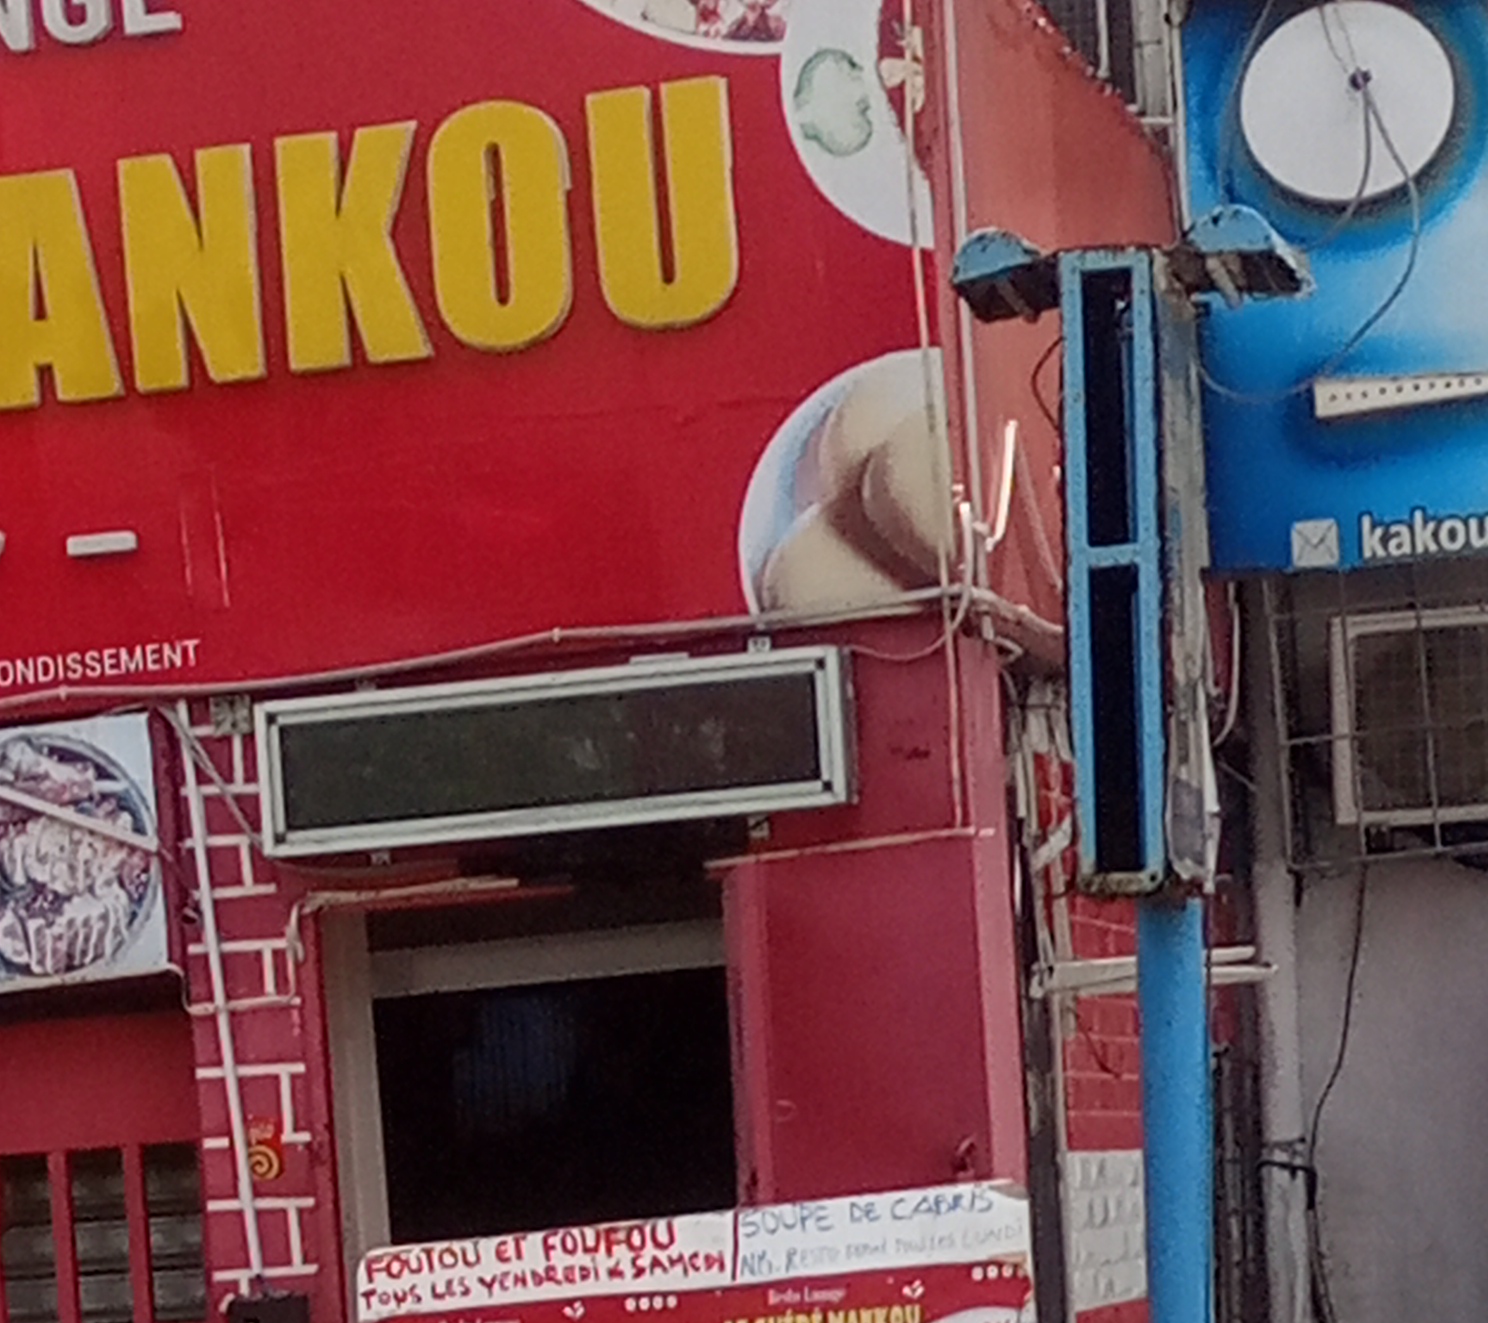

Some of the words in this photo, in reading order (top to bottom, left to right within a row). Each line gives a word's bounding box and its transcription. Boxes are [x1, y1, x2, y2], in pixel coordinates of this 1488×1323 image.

[1360, 508, 1488, 560] kakou
[740, 1204, 834, 1238] SOUPE
[890, 1188, 995, 1221] CABRIS
[365, 1243, 482, 1284] FOUTOU
[541, 1219, 677, 1263] FOUFOU
[430, 1275, 472, 1300] LES
